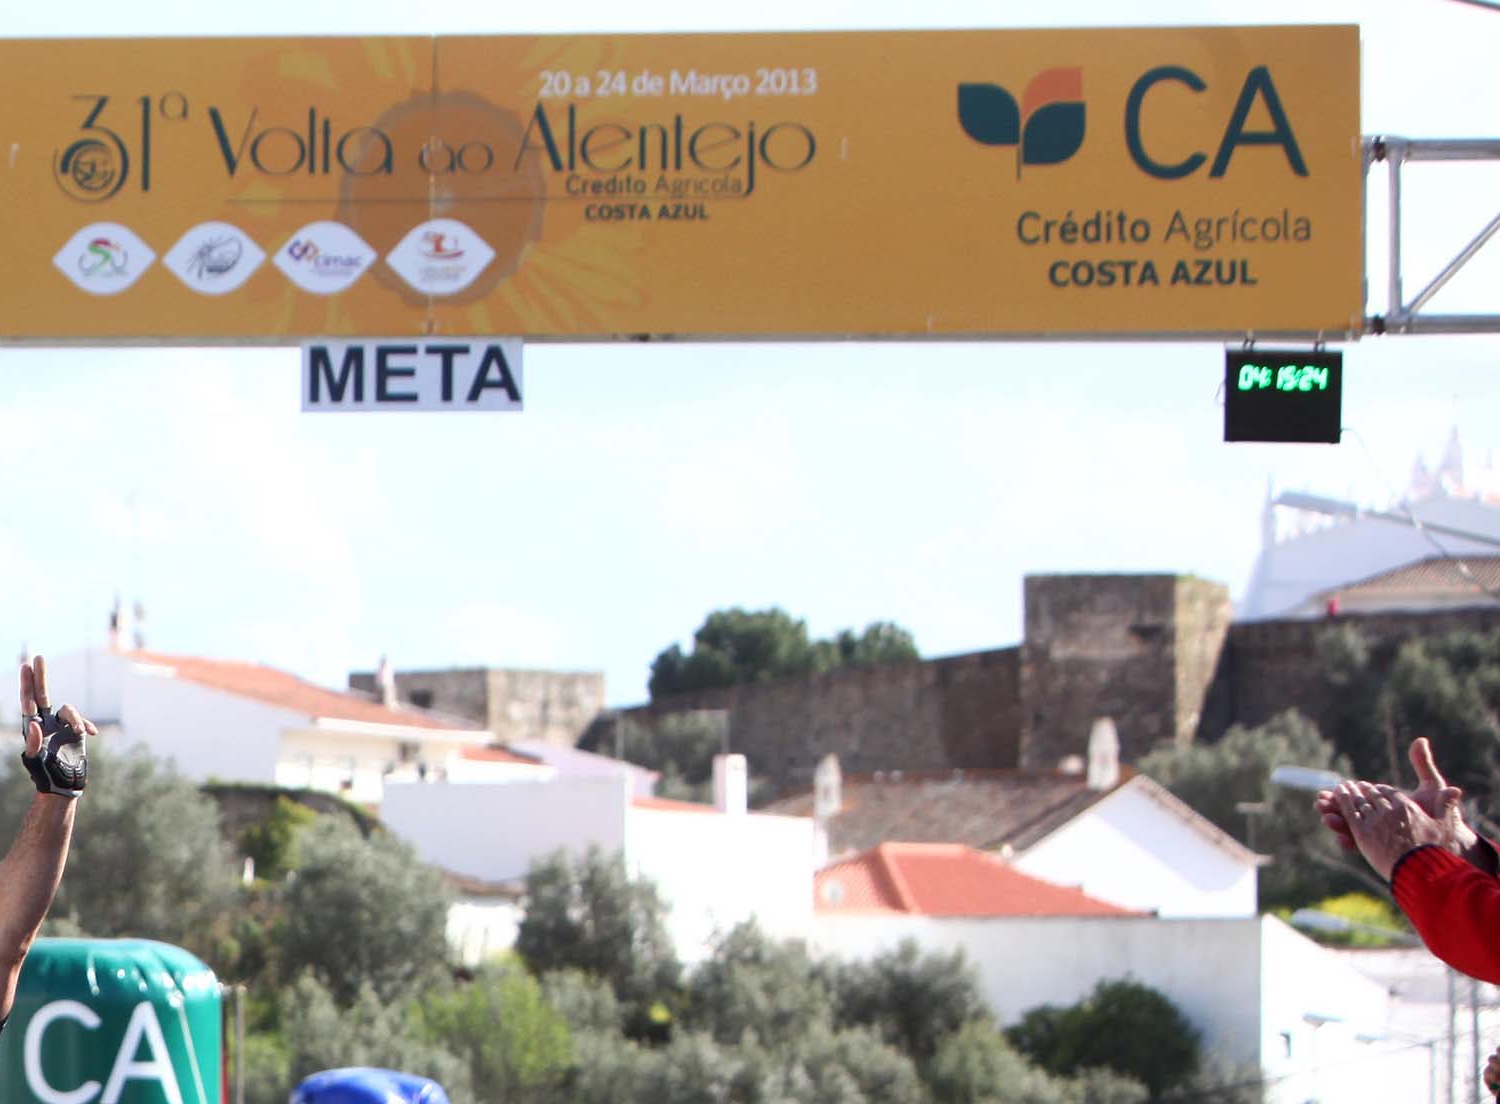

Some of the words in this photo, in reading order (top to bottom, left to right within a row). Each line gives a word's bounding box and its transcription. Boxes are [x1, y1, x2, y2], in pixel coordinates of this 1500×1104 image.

[539, 70, 571, 97] 20
[574, 77, 590, 97] a
[597, 70, 626, 96] 24
[632, 69, 664, 96] de
[668, 69, 750, 100] Março
[756, 68, 818, 95] 2013
[1124, 64, 1310, 180] CA
[207, 104, 394, 179] Volta
[418, 140, 495, 175] ao
[513, 101, 818, 198] Alentejo
[585, 203, 651, 221] COSTA
[658, 203, 709, 220] AZUL
[1016, 211, 1150, 245] Crédito
[1164, 209, 1312, 251] Agrícola
[315, 253, 363, 269] cimac
[1048, 260, 1159, 288] COSTA
[1170, 259, 1257, 287] AZUL
[309, 345, 522, 403] META
